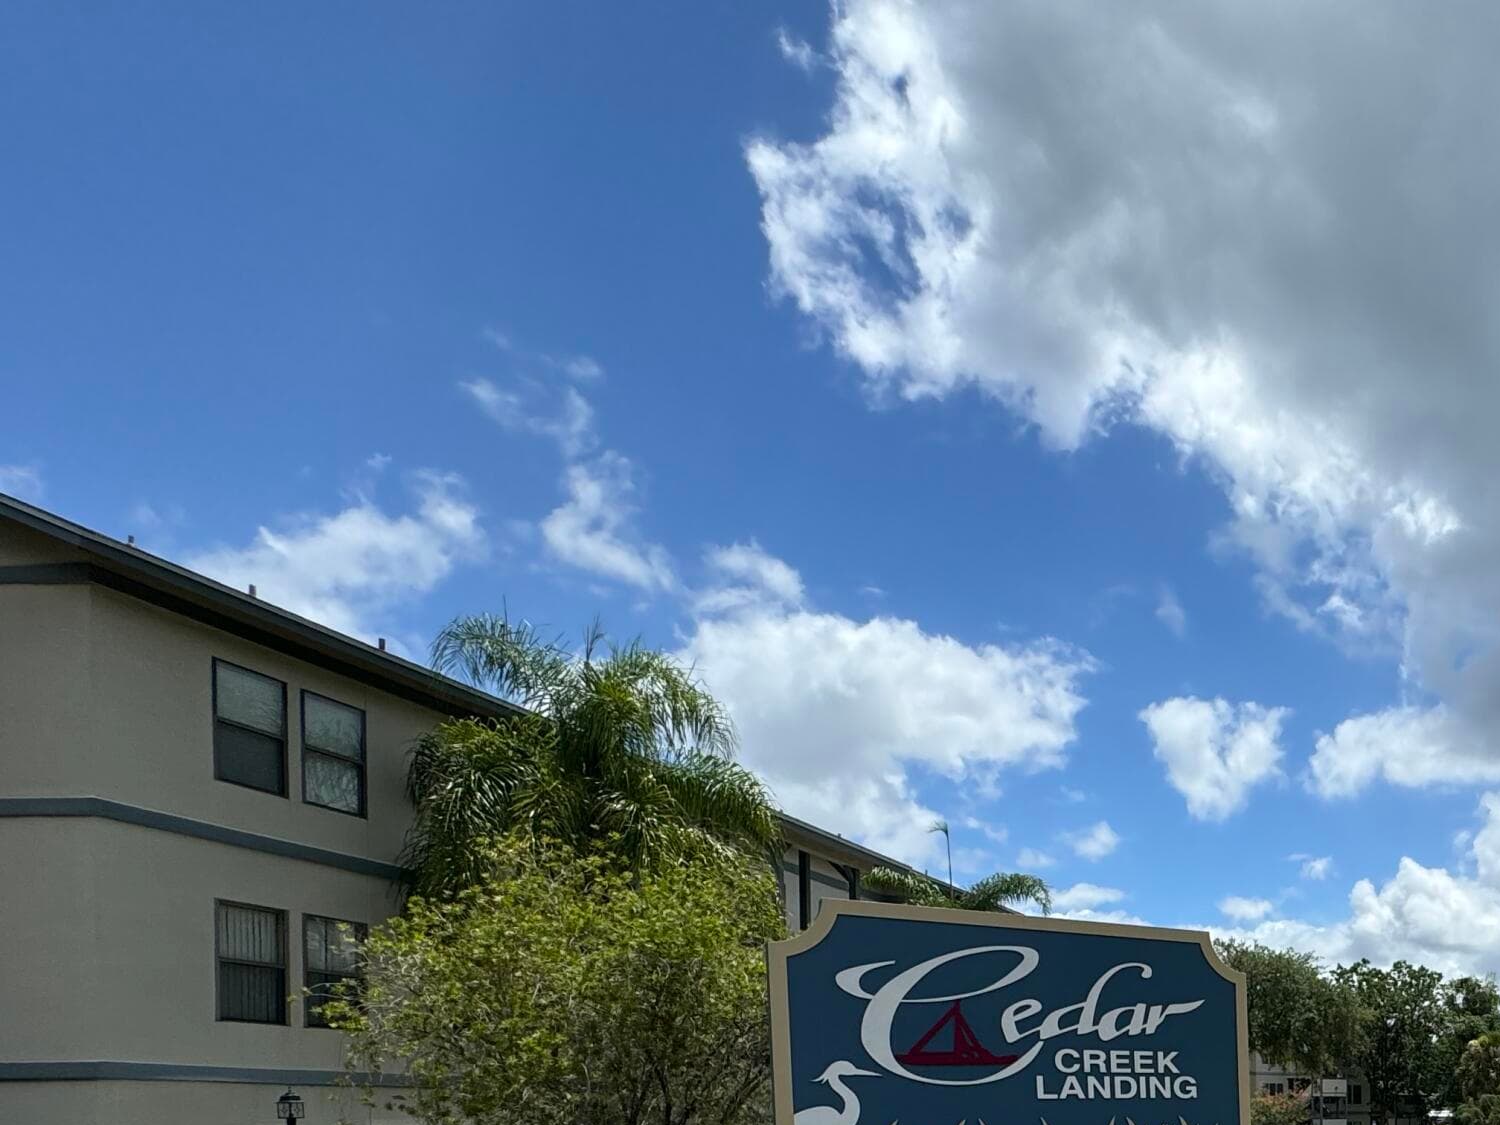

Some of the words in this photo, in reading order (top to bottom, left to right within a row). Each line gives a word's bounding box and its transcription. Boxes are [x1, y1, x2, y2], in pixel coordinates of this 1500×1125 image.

[835, 945, 1205, 1086] Cedar
[1054, 1048, 1181, 1075] CREEK
[1035, 1074, 1199, 1101] LANDING
